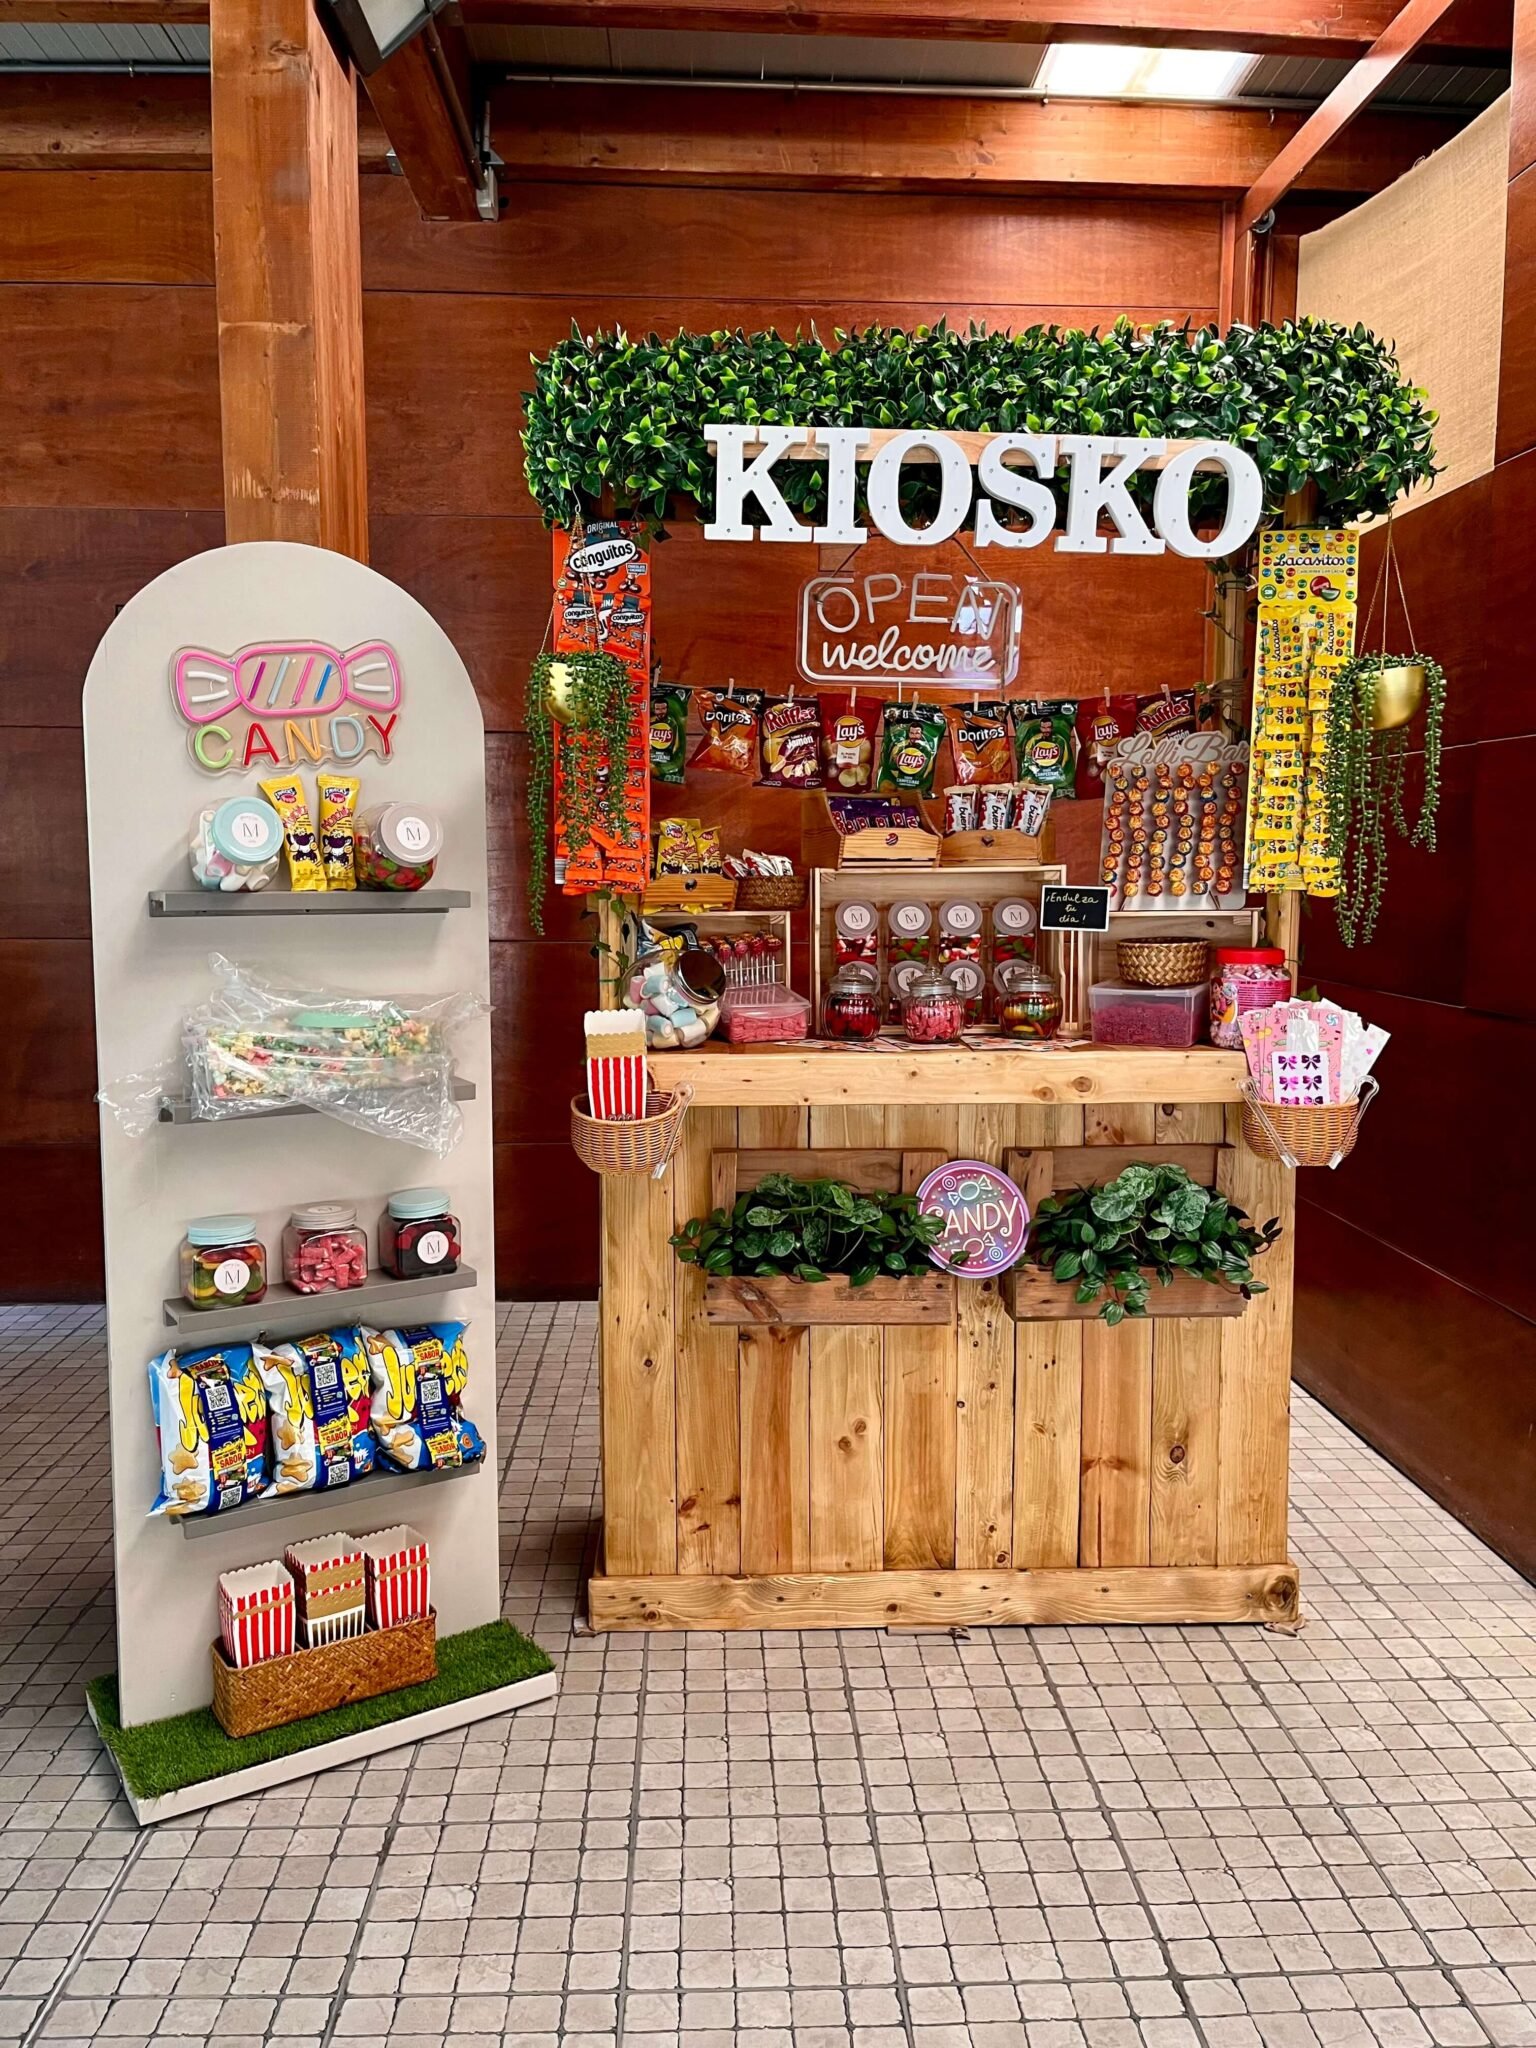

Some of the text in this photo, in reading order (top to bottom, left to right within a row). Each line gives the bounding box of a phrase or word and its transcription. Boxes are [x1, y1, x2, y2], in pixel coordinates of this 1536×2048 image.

[703, 424, 1263, 558] KIOSKO
[586, 521, 619, 534] ORIGINAL
[1273, 552, 1345, 567] Lacasitos
[816, 573, 1004, 640] OPEN
[822, 625, 996, 672] welcome
[705, 710, 752, 726] Doritos
[763, 706, 816, 734] Ruffles
[1136, 699, 1191, 732] Ruffles
[836, 722, 865, 742] Lay's
[958, 726, 1005, 742] Doritos
[1094, 722, 1120, 741] Lay's
[194, 713, 398, 769] CANDY
[1110, 731, 1250, 766] Lolli Bar
[1025, 804, 1040, 834] bueno
[242, 822, 259, 838] M
[405, 827, 421, 841] M
[1009, 911, 1022, 922] M
[1065, 904, 1077, 913] tu
[851, 912, 864, 924] M
[904, 912, 918, 924] M
[955, 912, 968, 923] M
[427, 1239, 440, 1255] M
[225, 1269, 240, 1285] M
[419, 1348, 440, 1361] SABOR
[325, 1430, 348, 1444] SABOR
[219, 1452, 243, 1468] SABOR
